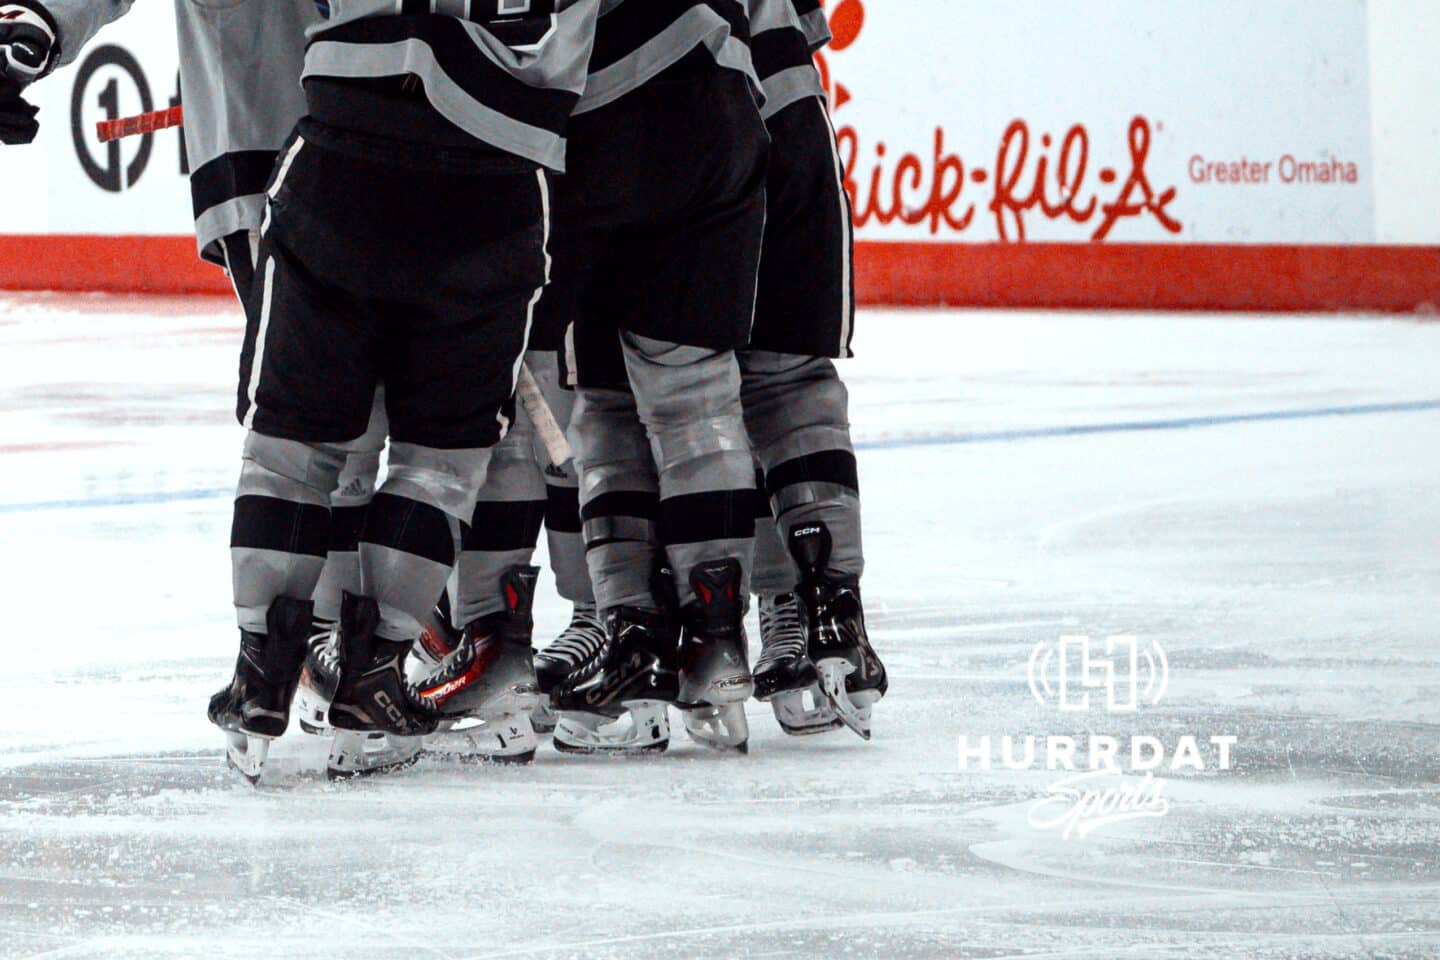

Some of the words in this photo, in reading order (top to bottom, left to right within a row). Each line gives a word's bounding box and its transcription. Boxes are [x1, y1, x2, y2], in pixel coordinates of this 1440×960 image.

[837, 116, 1182, 240] hick-fil-A
[1188, 154, 1272, 183] Greater
[1279, 154, 1358, 183] Omaha
[794, 526, 821, 537] CCM
